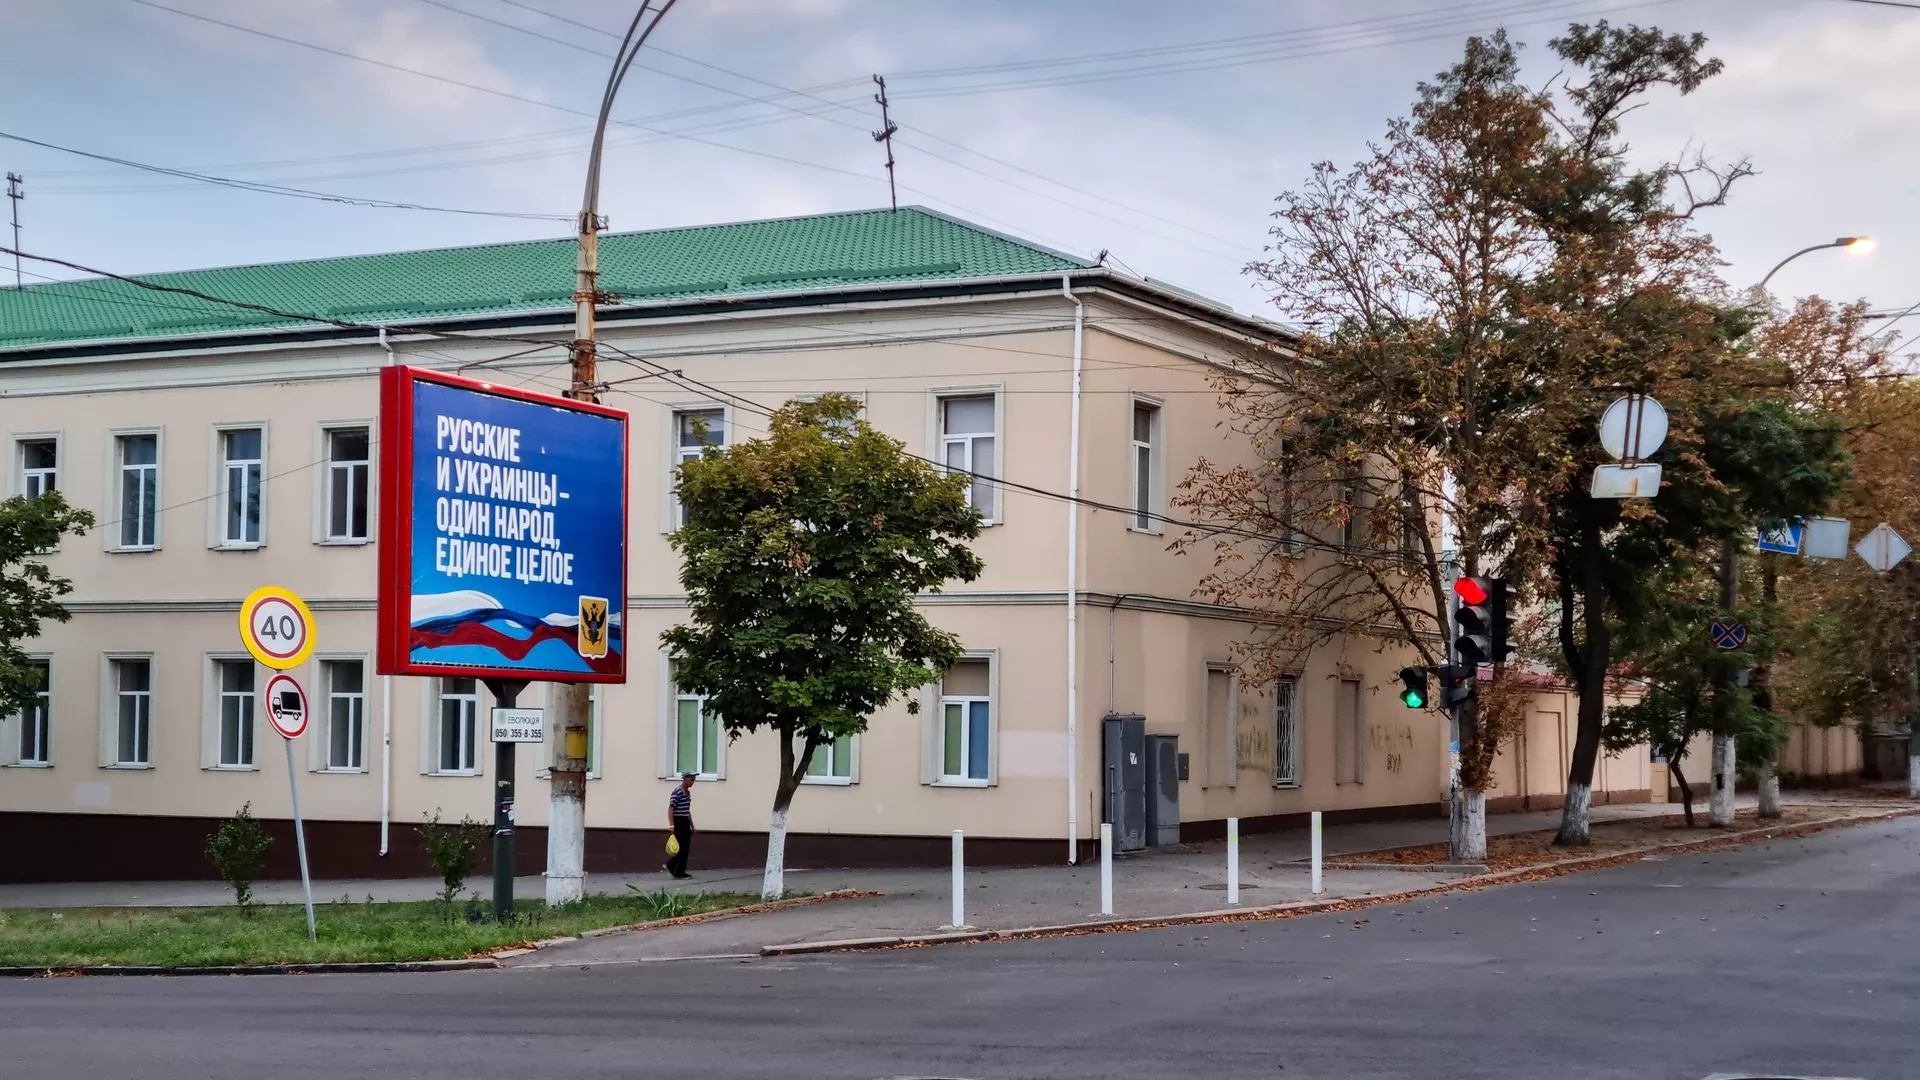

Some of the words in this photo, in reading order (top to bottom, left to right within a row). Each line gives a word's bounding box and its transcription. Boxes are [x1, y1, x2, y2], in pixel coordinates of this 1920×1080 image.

[436, 414, 521, 463] РУССКИЕ
[436, 455, 450, 492] И
[454, 459, 557, 508] УКРАИНЦЫ
[436, 496, 490, 537] ОДИН
[494, 505, 561, 551] НАРОД,
[436, 537, 512, 579] ЕДИНОЕ
[515, 547, 574, 586] ЦЕЛОЕ
[260, 615, 295, 640] 40
